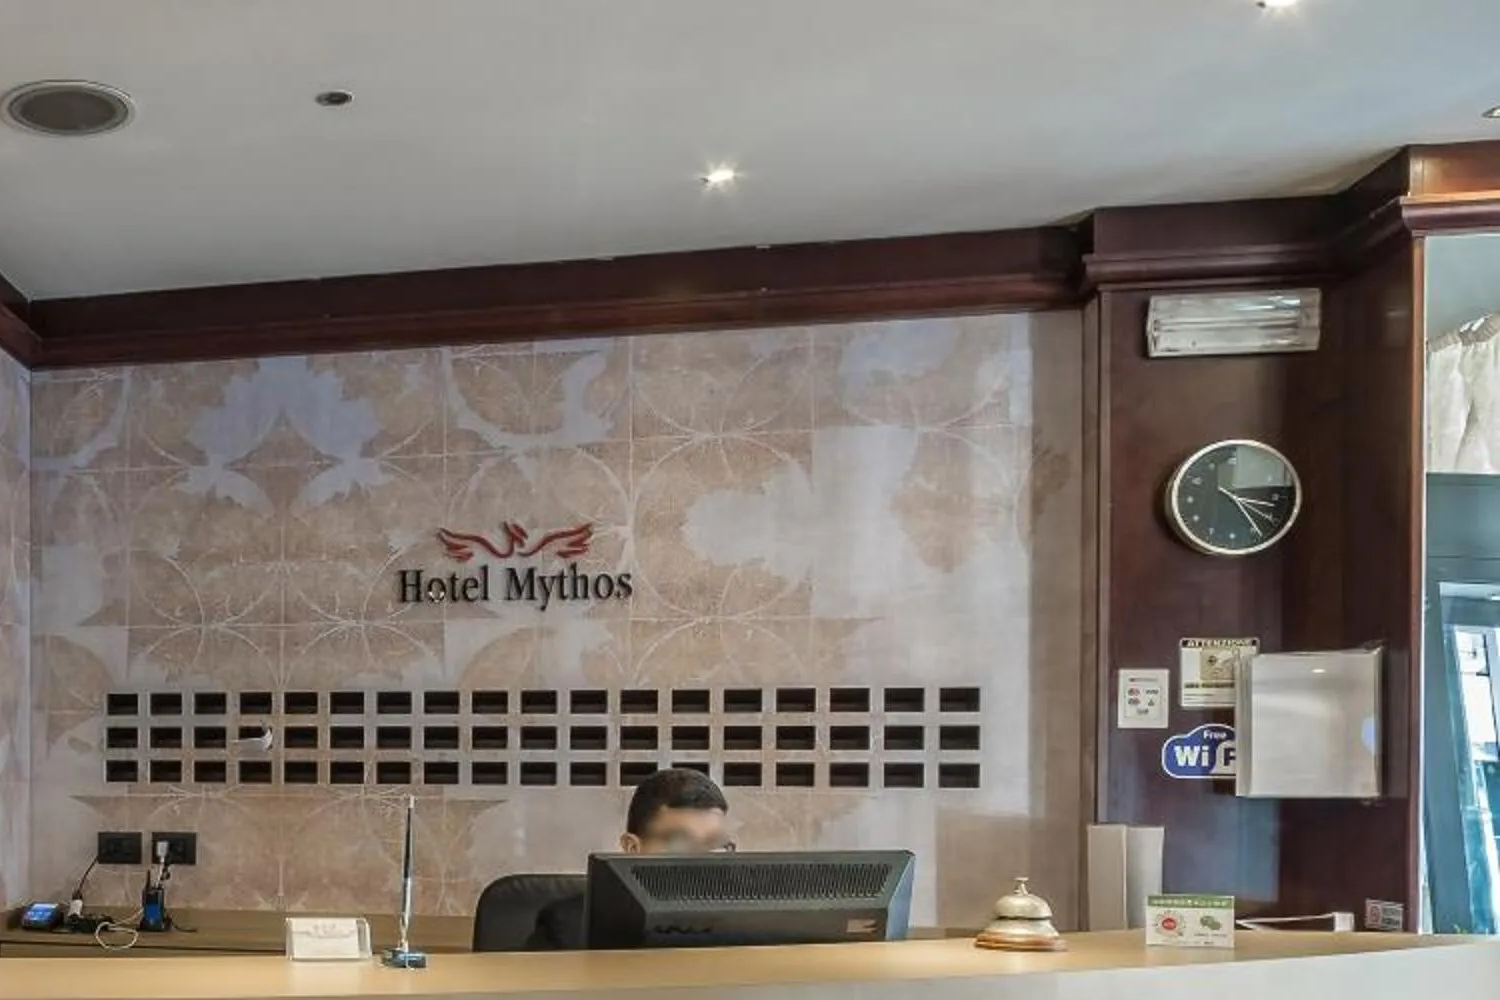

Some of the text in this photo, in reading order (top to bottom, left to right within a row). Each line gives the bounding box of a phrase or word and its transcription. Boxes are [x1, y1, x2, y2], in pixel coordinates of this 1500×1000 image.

[398, 562, 633, 611] Hotel Mythos
[1203, 729, 1227, 740] Free
